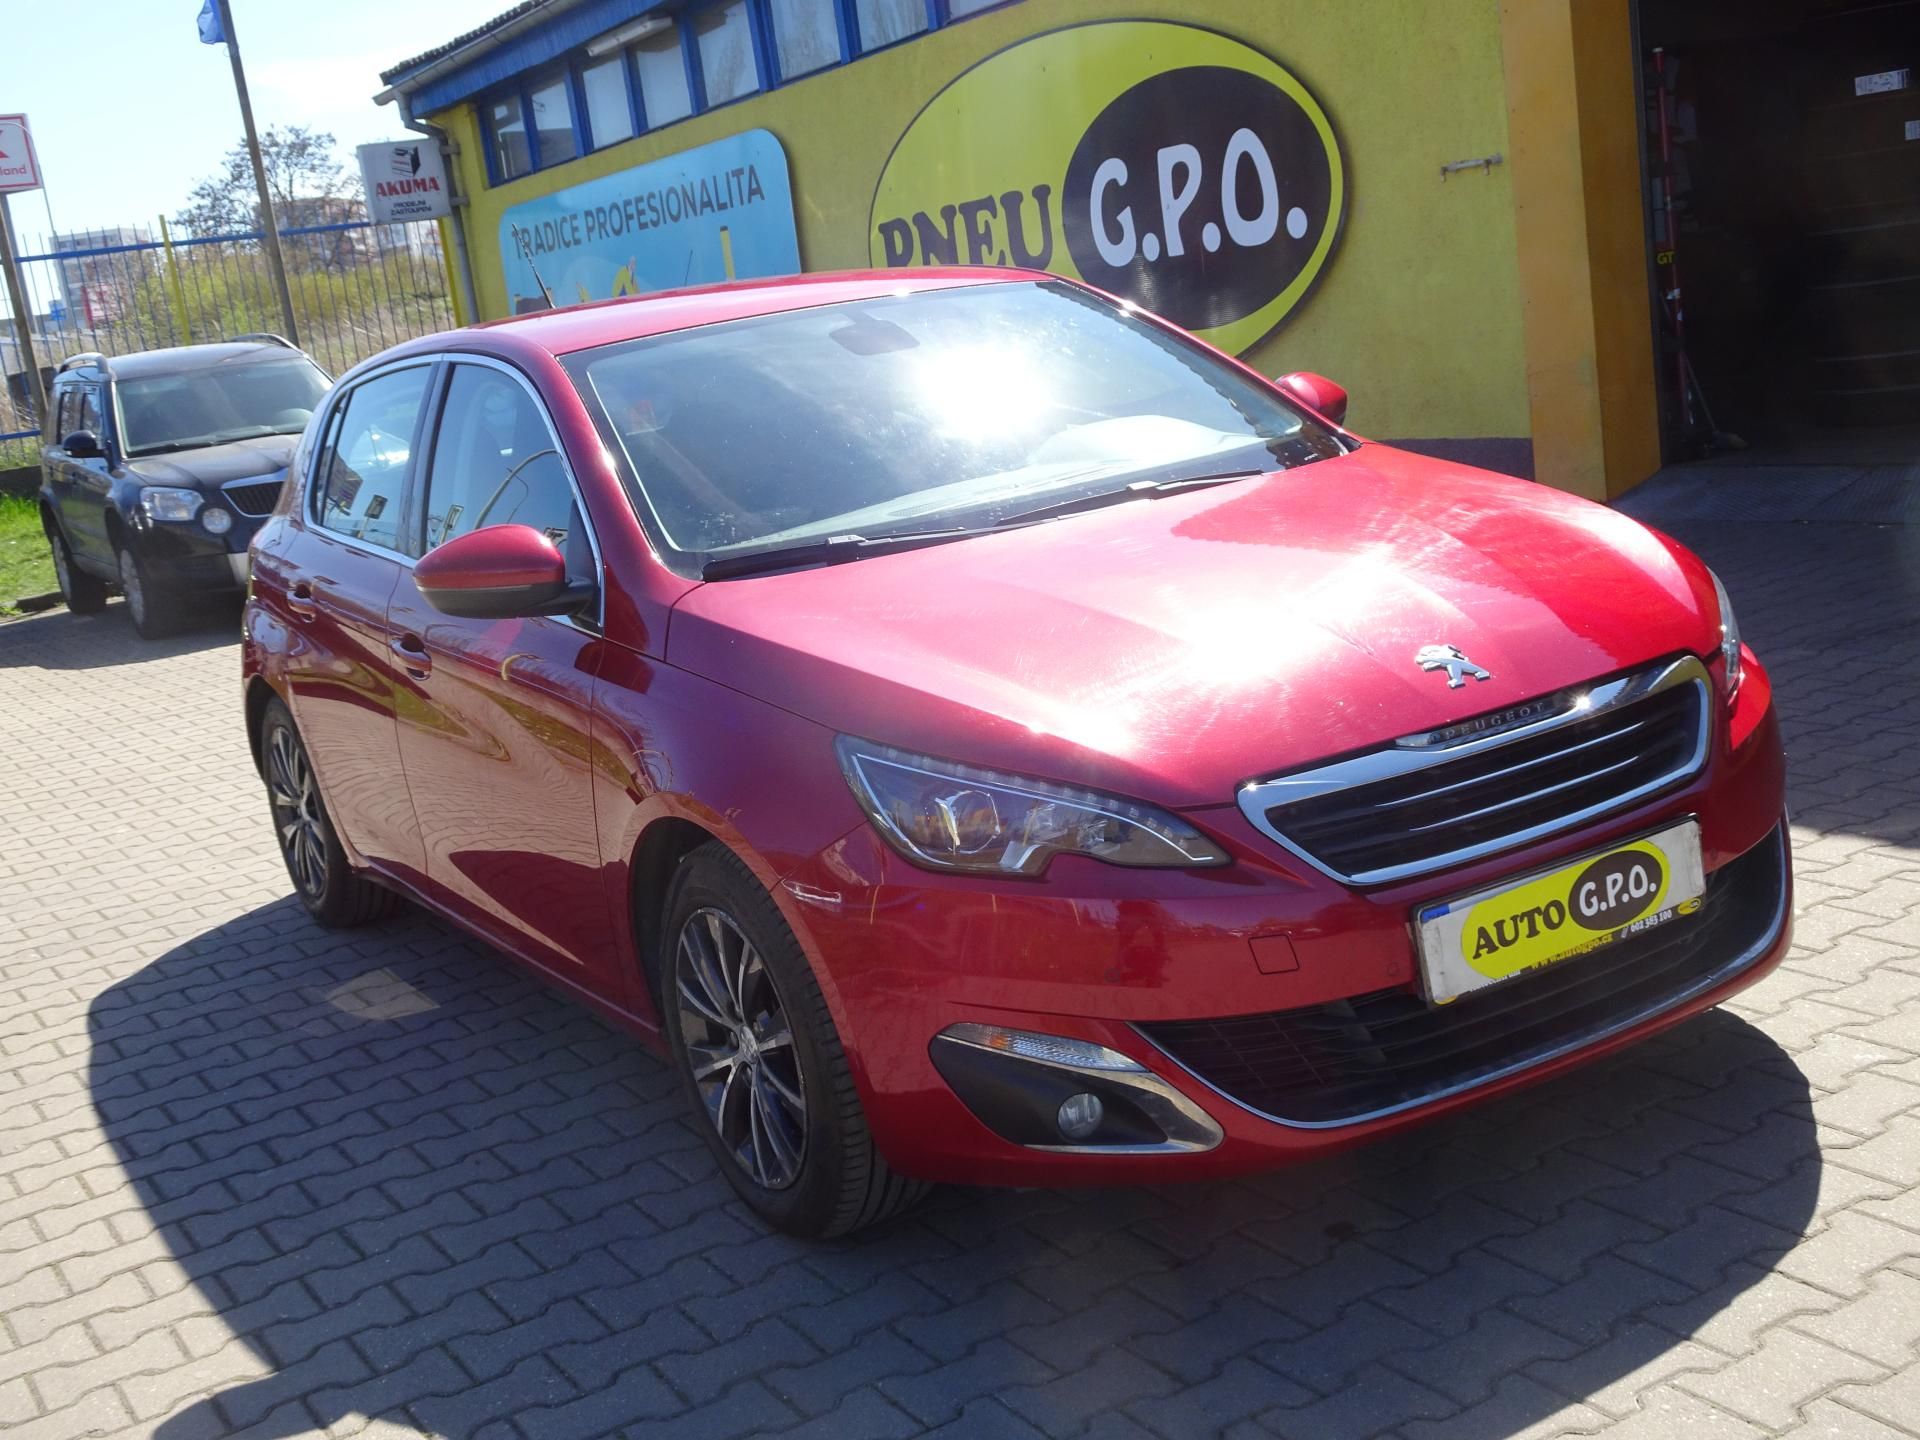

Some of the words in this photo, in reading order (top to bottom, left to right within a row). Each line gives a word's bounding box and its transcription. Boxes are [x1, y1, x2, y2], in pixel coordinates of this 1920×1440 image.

[376, 176, 440, 197] AKUMA
[511, 213, 582, 259] TRADICE
[584, 164, 765, 243] PROFESIONALITA
[878, 184, 1053, 269] PNEU
[1090, 127, 1308, 267] G.P.O.
[1446, 702, 1545, 739] PEUGEOT
[1472, 900, 1566, 959] AUTO
[1579, 864, 1657, 917] G.P.O.
